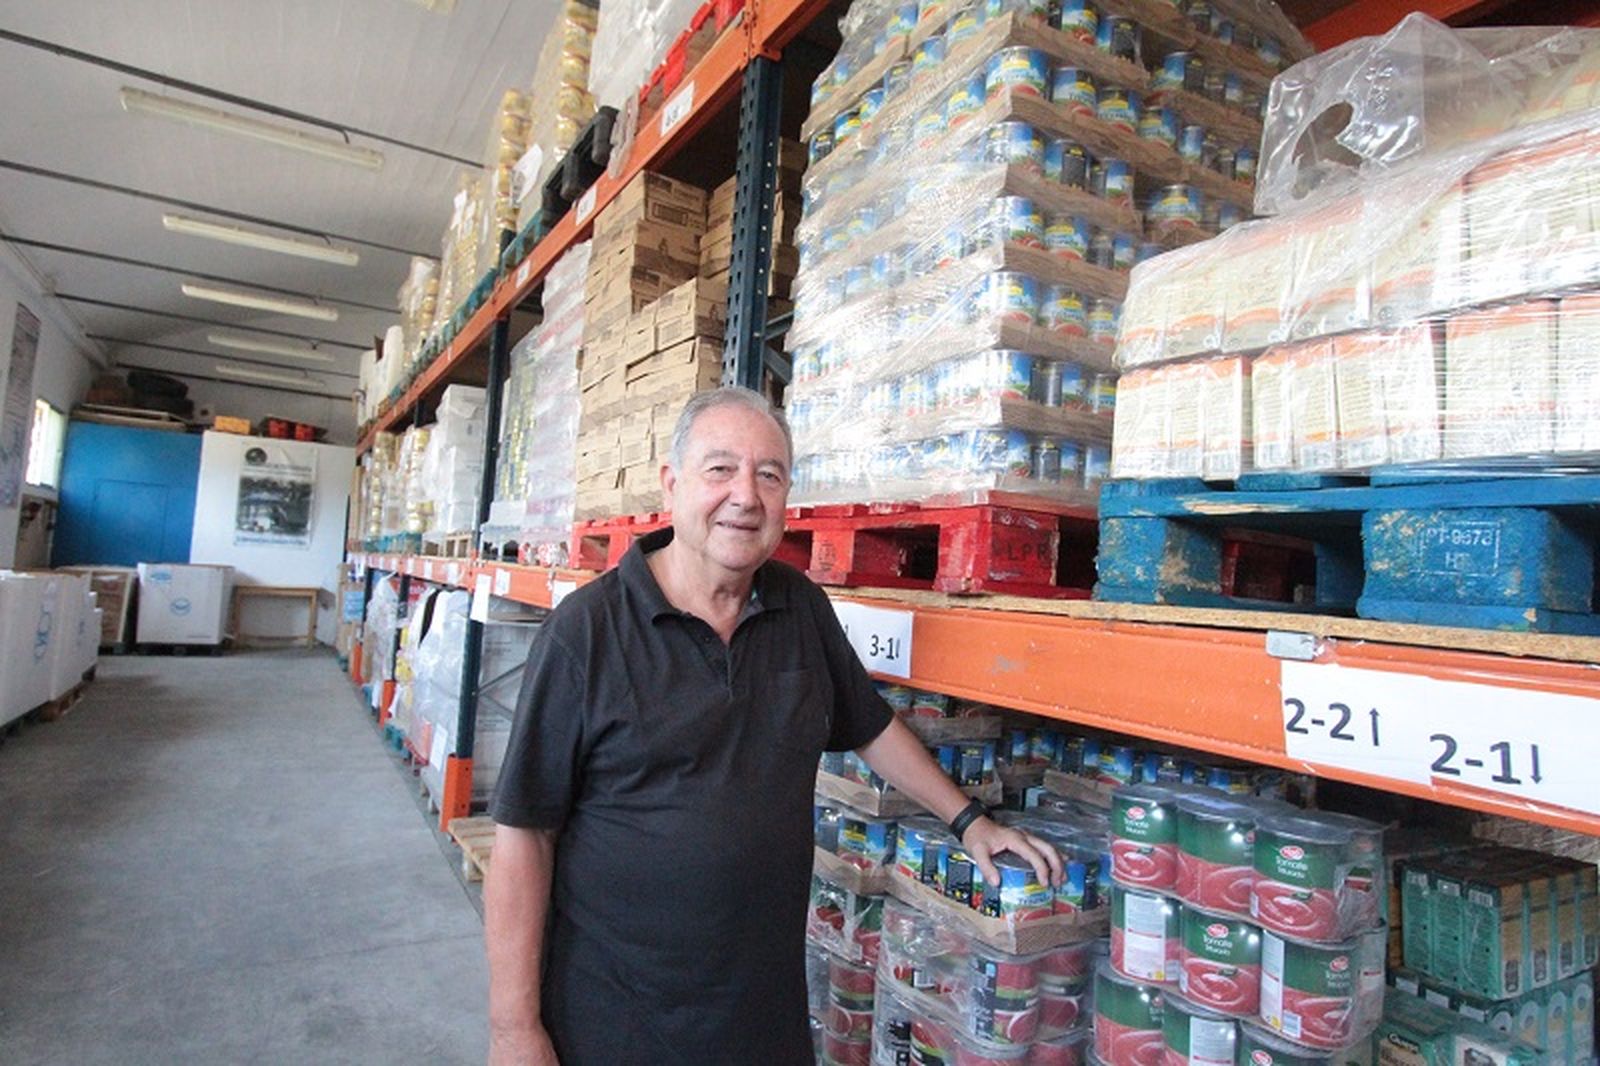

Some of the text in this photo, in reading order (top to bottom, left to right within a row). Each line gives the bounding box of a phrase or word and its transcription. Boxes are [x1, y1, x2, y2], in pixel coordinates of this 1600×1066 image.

[869, 634, 895, 660] 3-1
[1284, 697, 1355, 742] 2-2
[1429, 733, 1522, 785] 2-1
[1276, 855, 1309, 871] Tomate
[1202, 933, 1233, 949] Tomate
